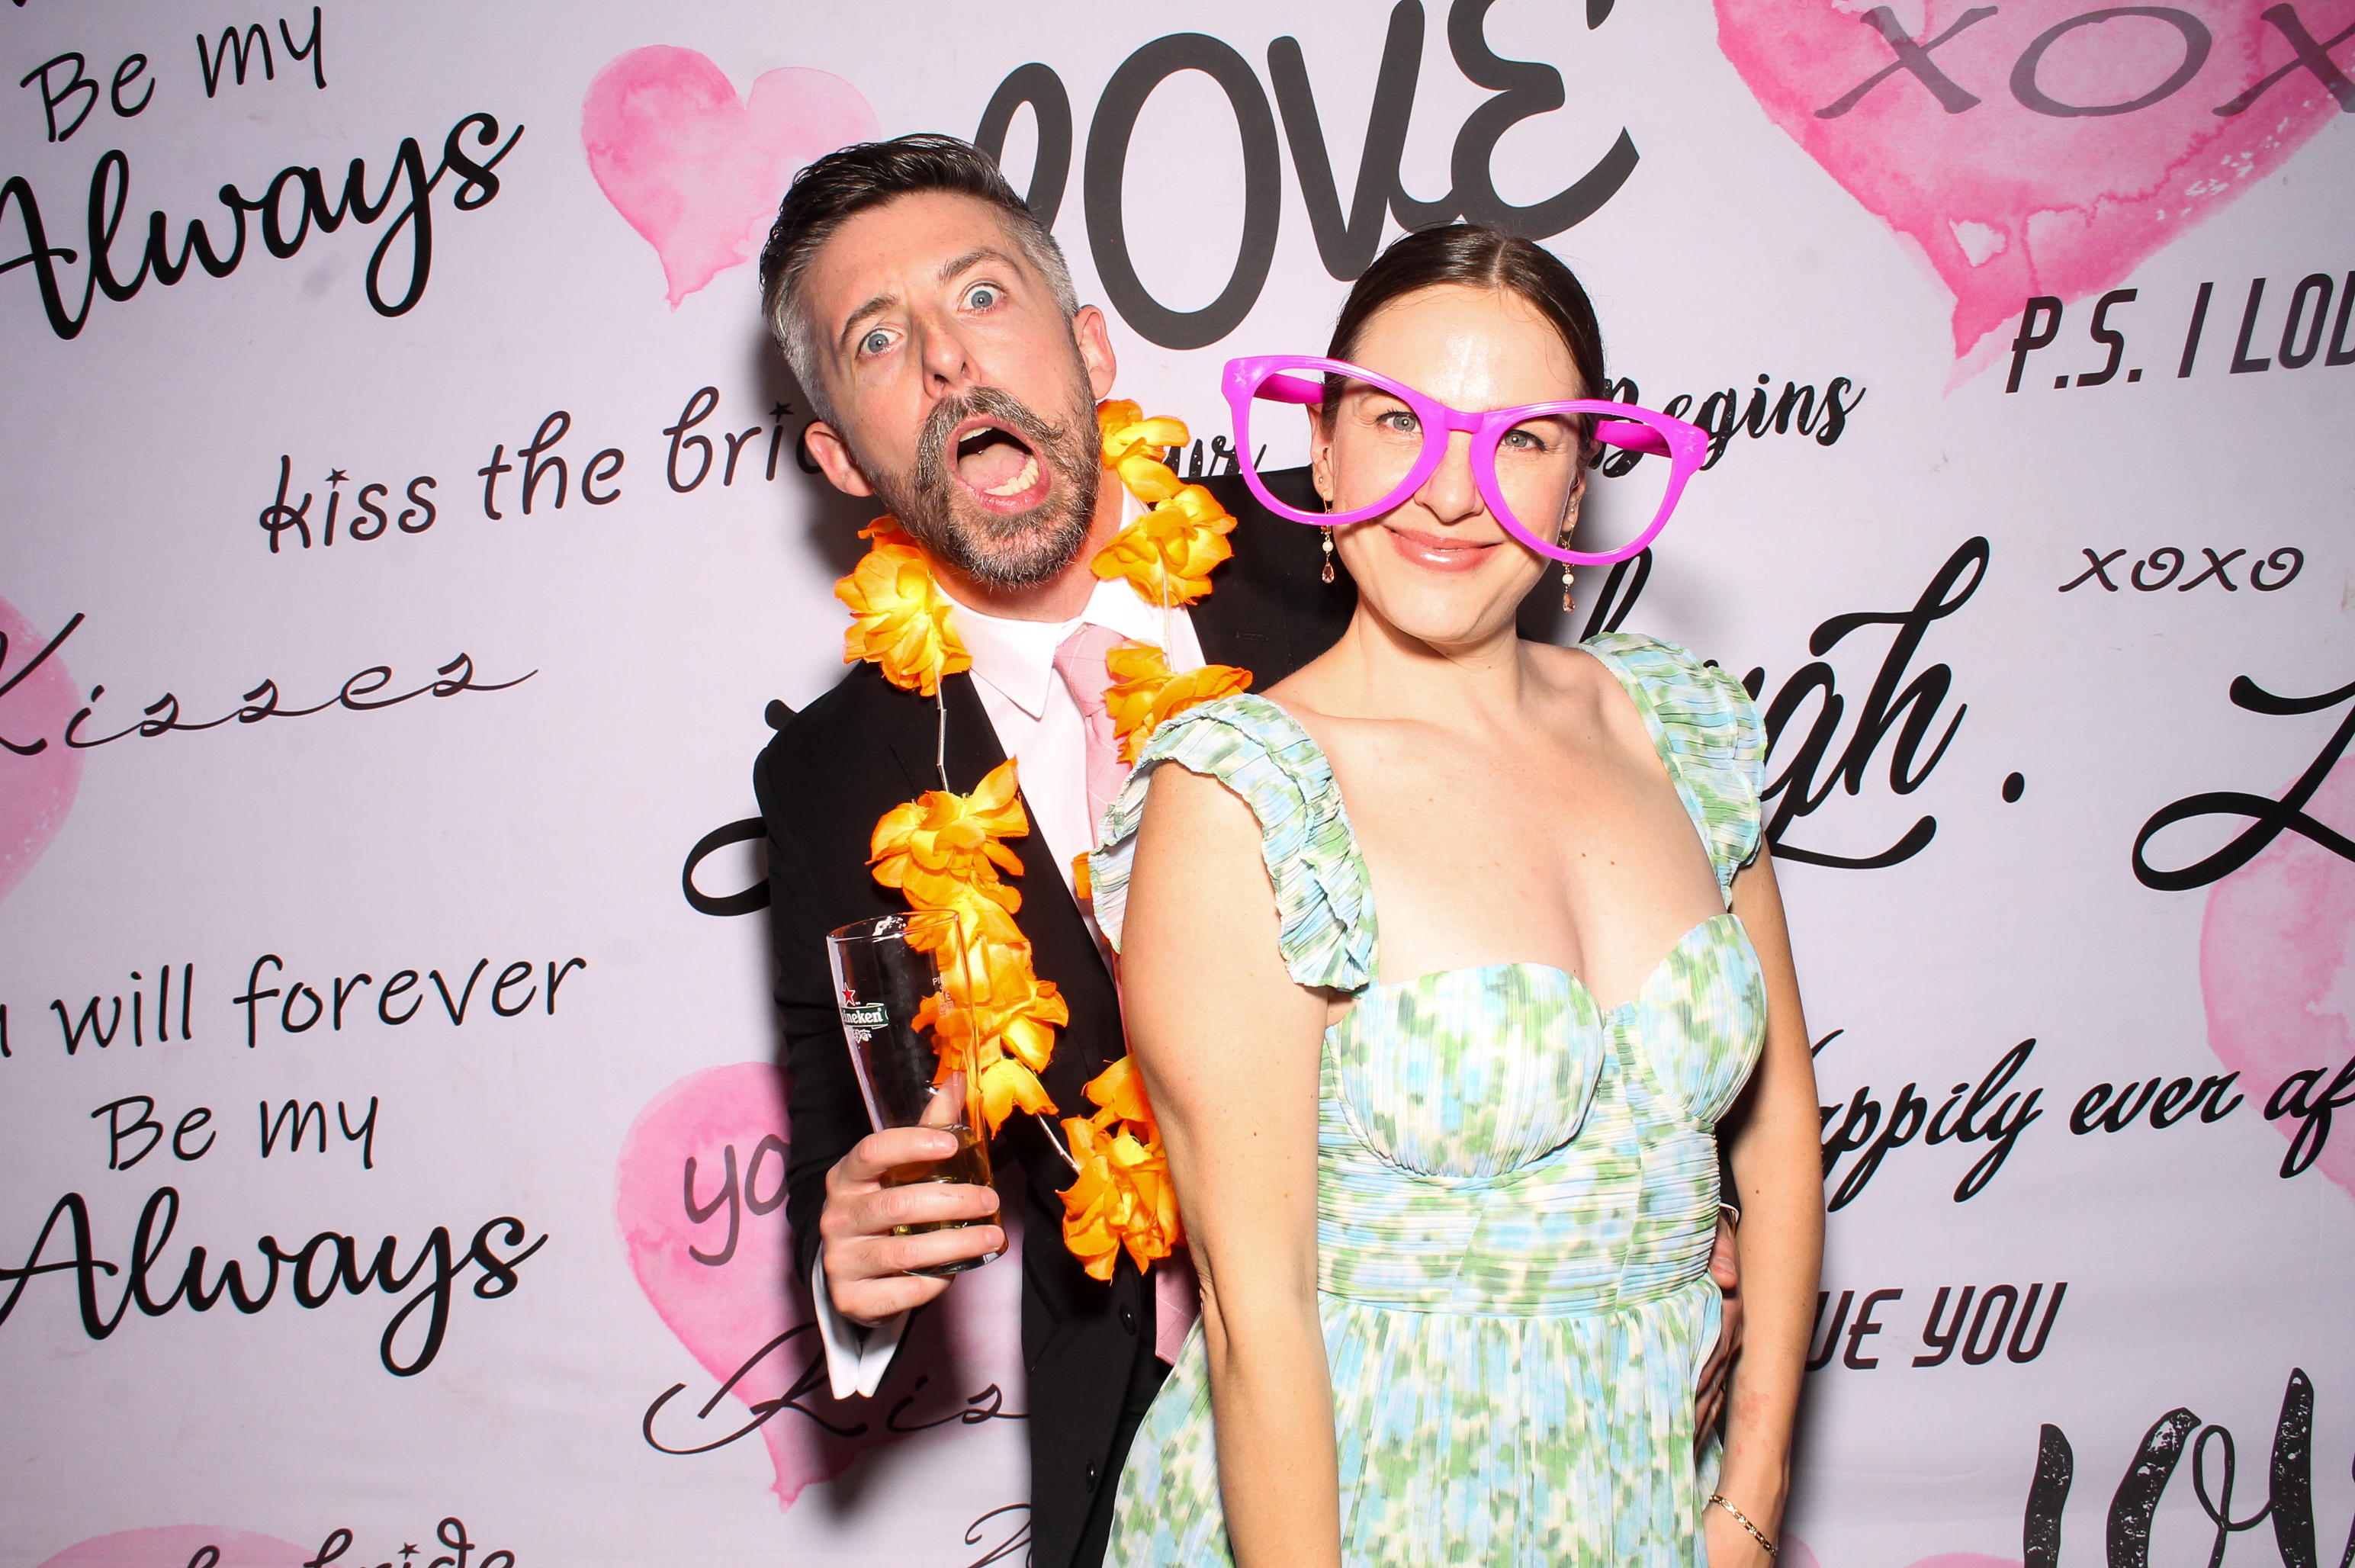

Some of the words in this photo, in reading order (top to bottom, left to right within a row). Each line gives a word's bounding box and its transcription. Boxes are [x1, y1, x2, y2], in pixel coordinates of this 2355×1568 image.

[20, 52, 155, 143] Be
[196, 6, 326, 98] my
[0, 112, 524, 340] Always
[2005, 288, 2143, 394] P.S.
[2177, 282, 2213, 378] I
[259, 455, 436, 554] kiss
[478, 410, 625, 520] the
[663, 386, 824, 493] bri
[50, 963, 194, 1055] will
[233, 954, 586, 1048] forever
[842, 1007, 883, 1023] ineken
[91, 1096, 216, 1171] Be
[260, 1096, 378, 1169] my
[1810, 1029, 2044, 1213] ppily
[2069, 1071, 2244, 1136] ever
[685, 1134, 790, 1267] yo
[0, 1187, 548, 1377] Always
[1912, 1282, 2067, 1367] YOU
